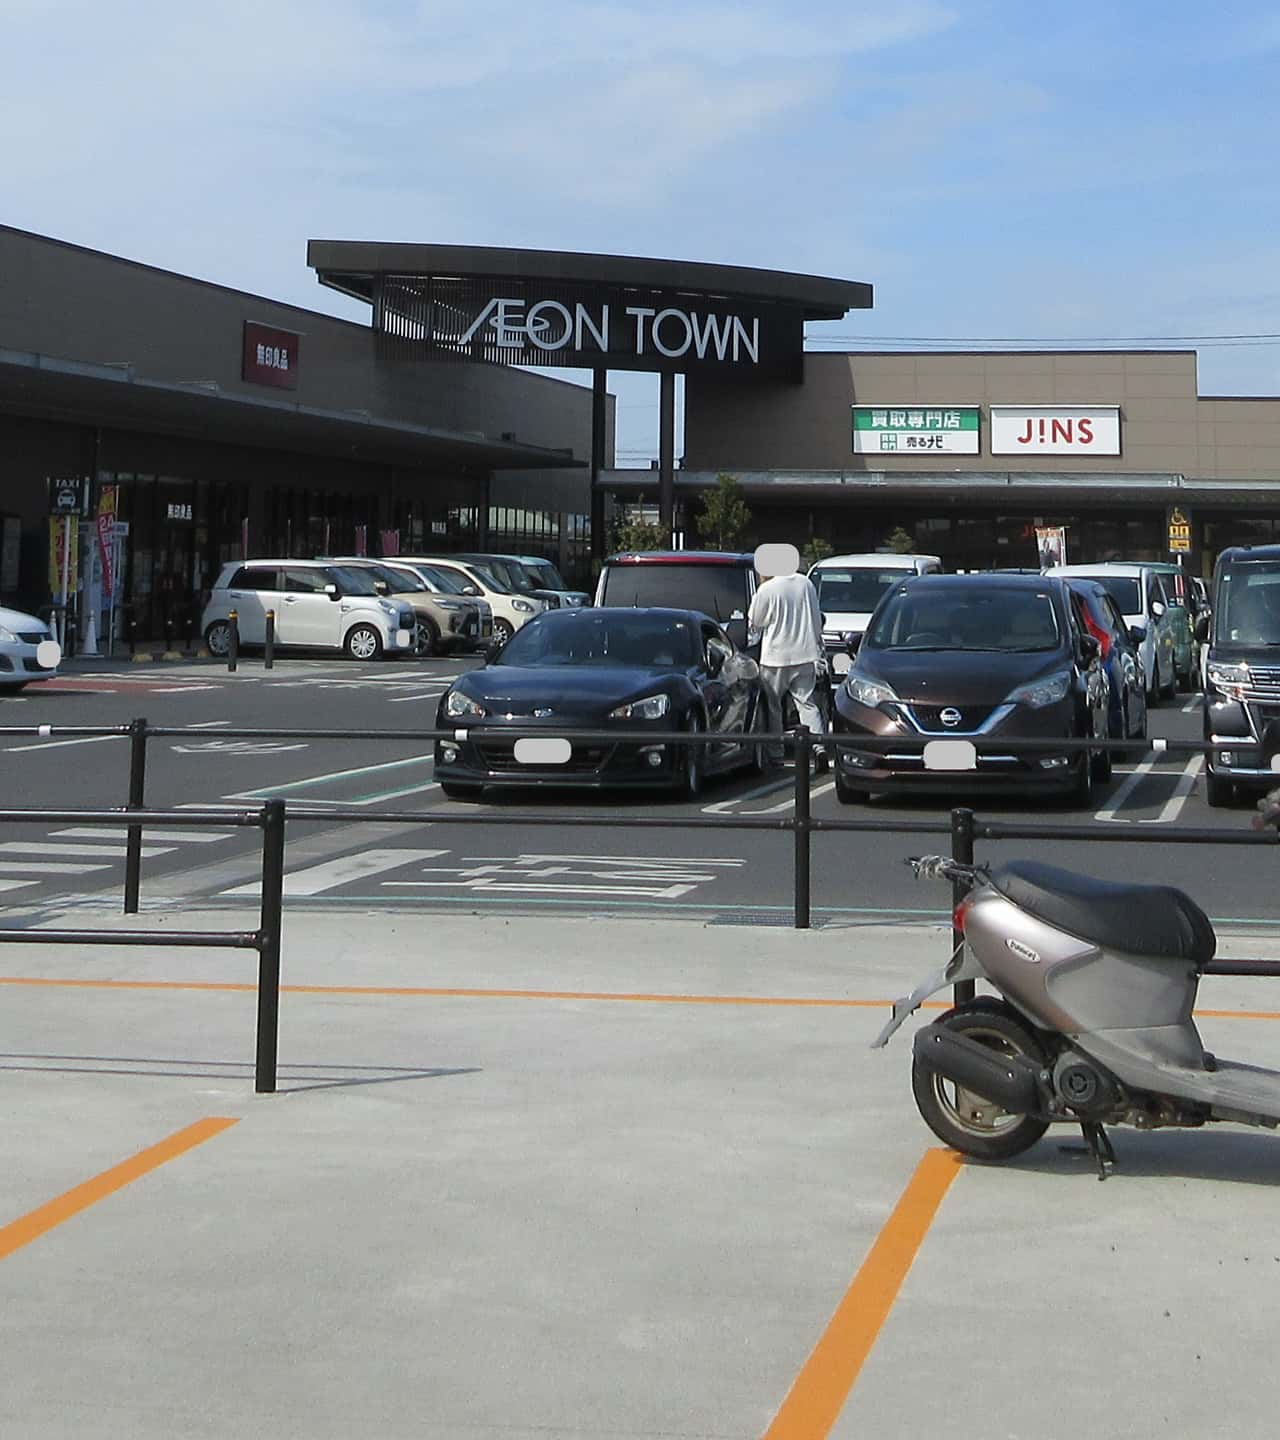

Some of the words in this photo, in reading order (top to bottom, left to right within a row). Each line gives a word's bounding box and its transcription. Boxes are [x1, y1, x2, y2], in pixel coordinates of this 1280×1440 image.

[626, 307, 760, 364] TOWN
[256, 343, 288, 370] 無印良品
[871, 410, 961, 428] 買取専門店
[906, 435, 943, 448] 売るナビ
[56, 479, 80, 488] TAXI
